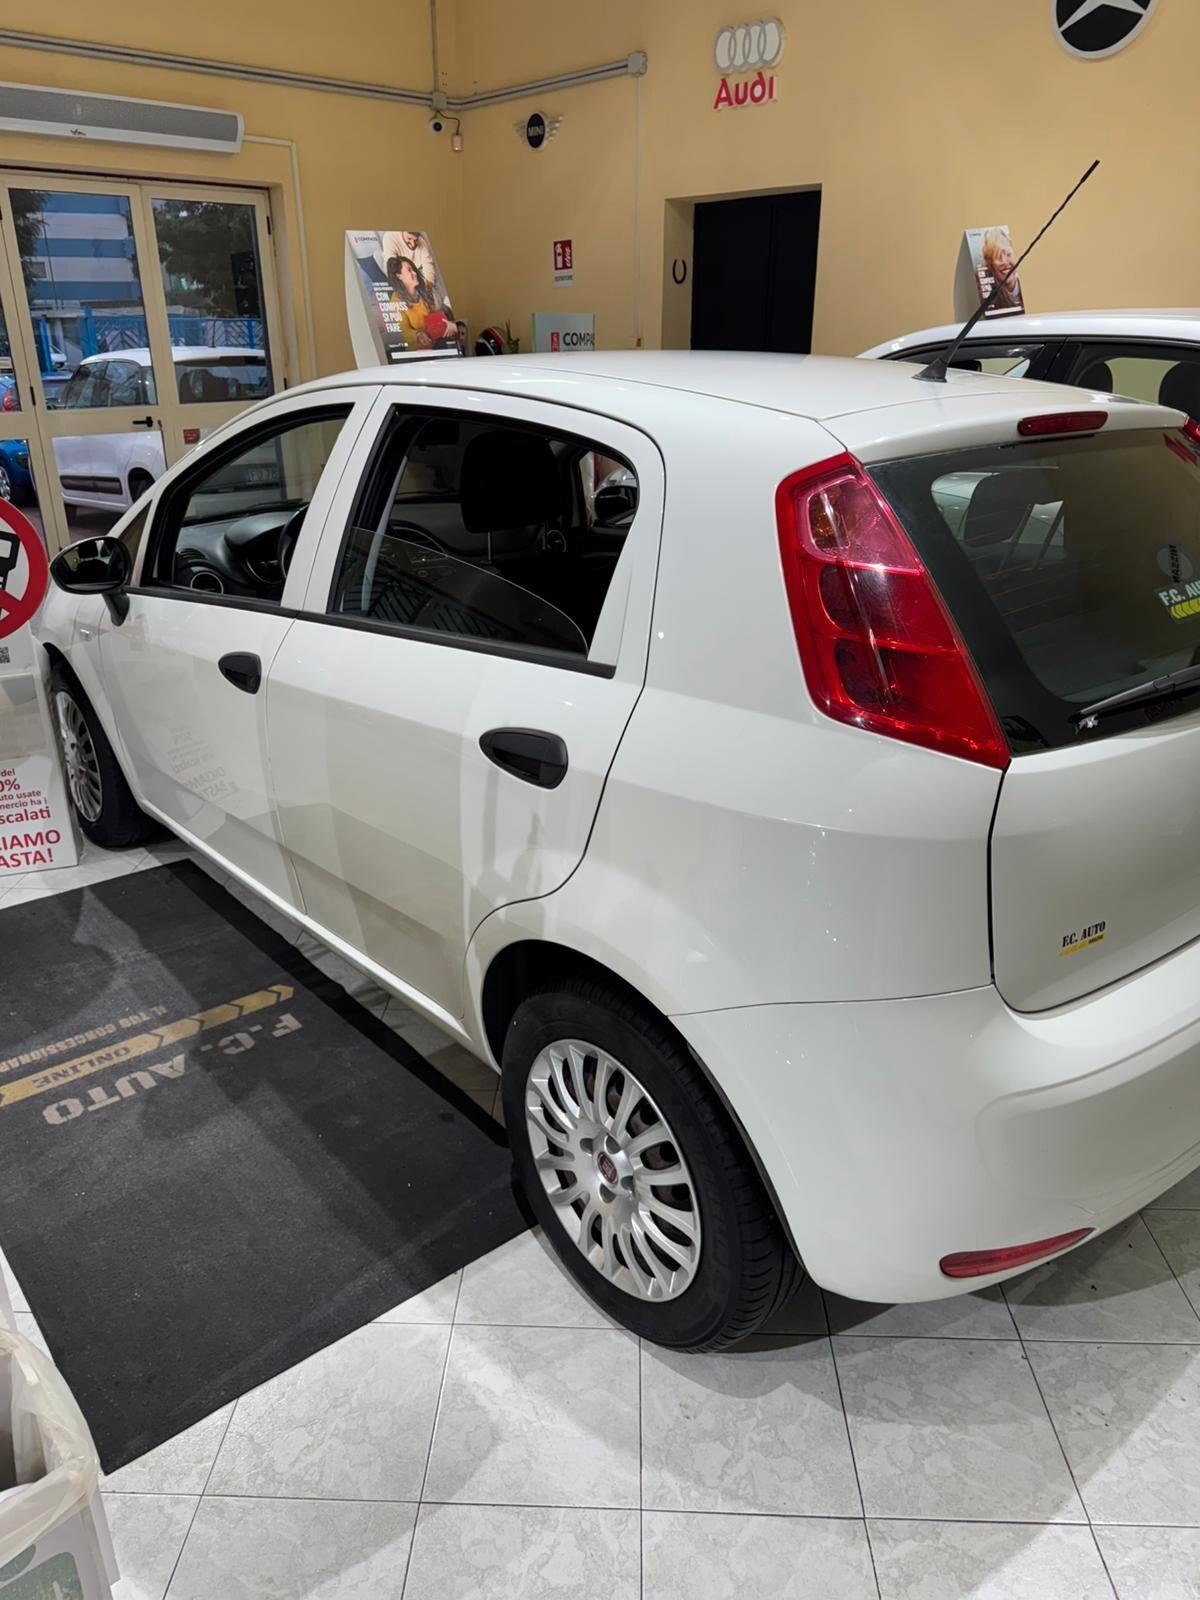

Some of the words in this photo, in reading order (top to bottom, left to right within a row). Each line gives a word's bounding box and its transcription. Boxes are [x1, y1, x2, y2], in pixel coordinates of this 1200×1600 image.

[714, 71, 775, 109] Audi
[528, 125, 544, 137] MINI
[1158, 588, 1186, 607] F.C.
[1184, 580, 1200, 598] AU
[1, 768, 16, 777] del
[16, 790, 42, 799] usate
[30, 798, 42, 806] ha
[0, 806, 51, 824] scalati
[0, 829, 61, 851] IAMO
[0, 848, 54, 869] ASTA!
[1081, 920, 1106, 940] AUTO
[201, 1013, 303, 1055] F.C.
[32, 1046, 131, 1089] ONLINE
[42, 1054, 187, 1125] AUTO
